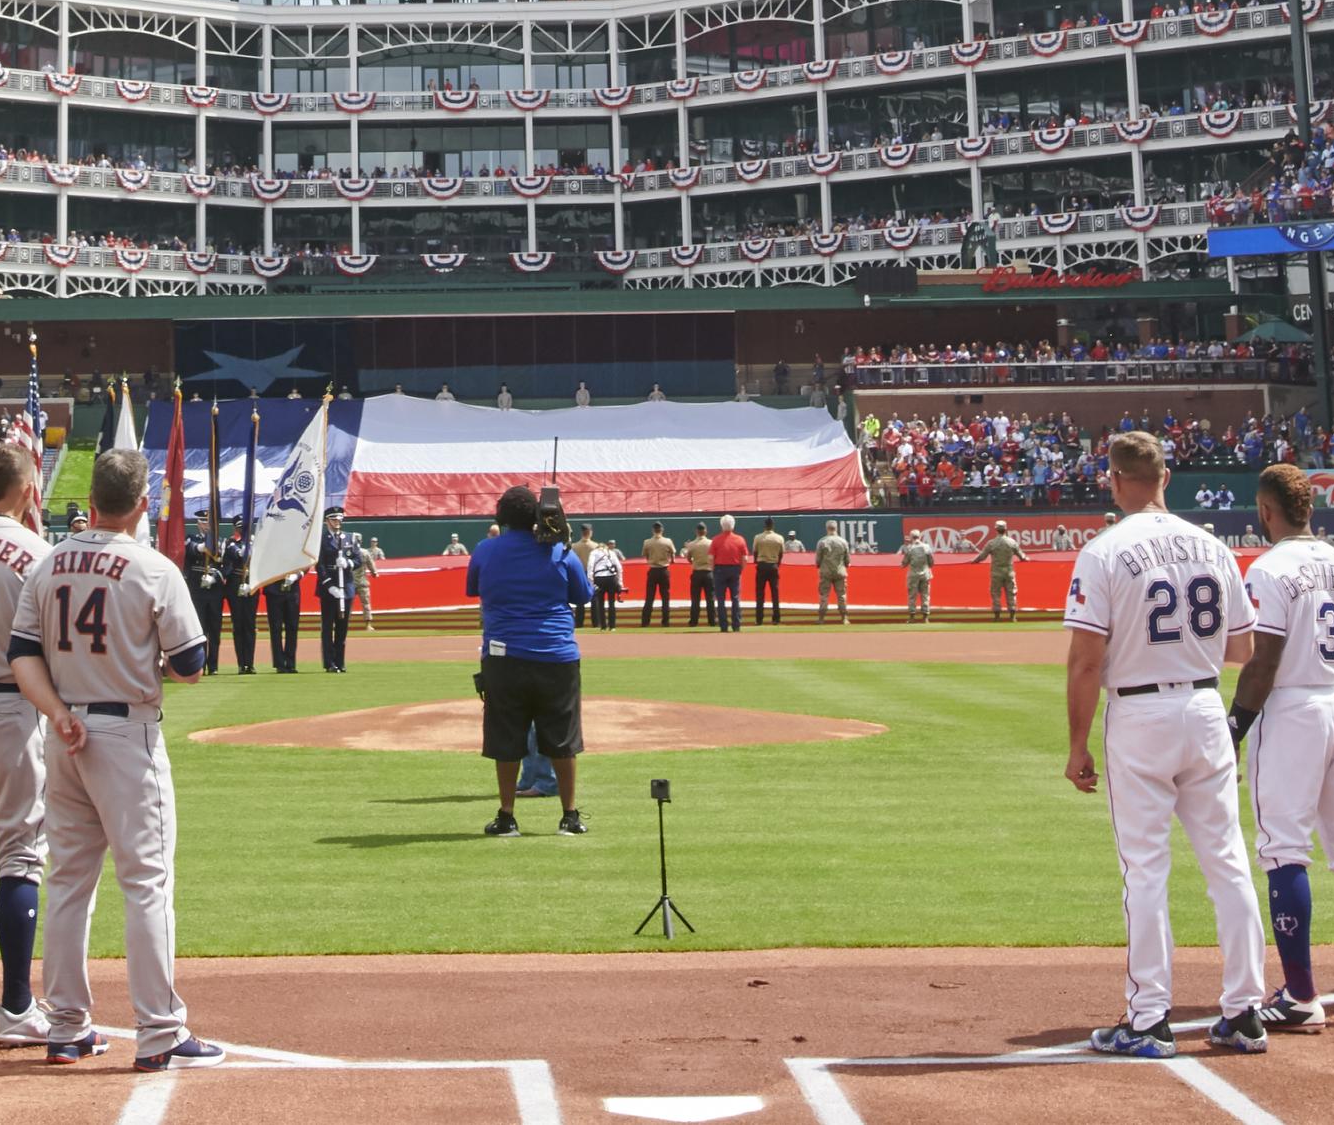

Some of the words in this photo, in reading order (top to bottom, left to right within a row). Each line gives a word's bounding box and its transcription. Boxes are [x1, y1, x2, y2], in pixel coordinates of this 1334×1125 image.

[52, 551, 130, 581] HINCH
[1119, 533, 1228, 580] BANISTER
[56, 584, 108, 655] 14
[1145, 575, 1224, 645] 28
